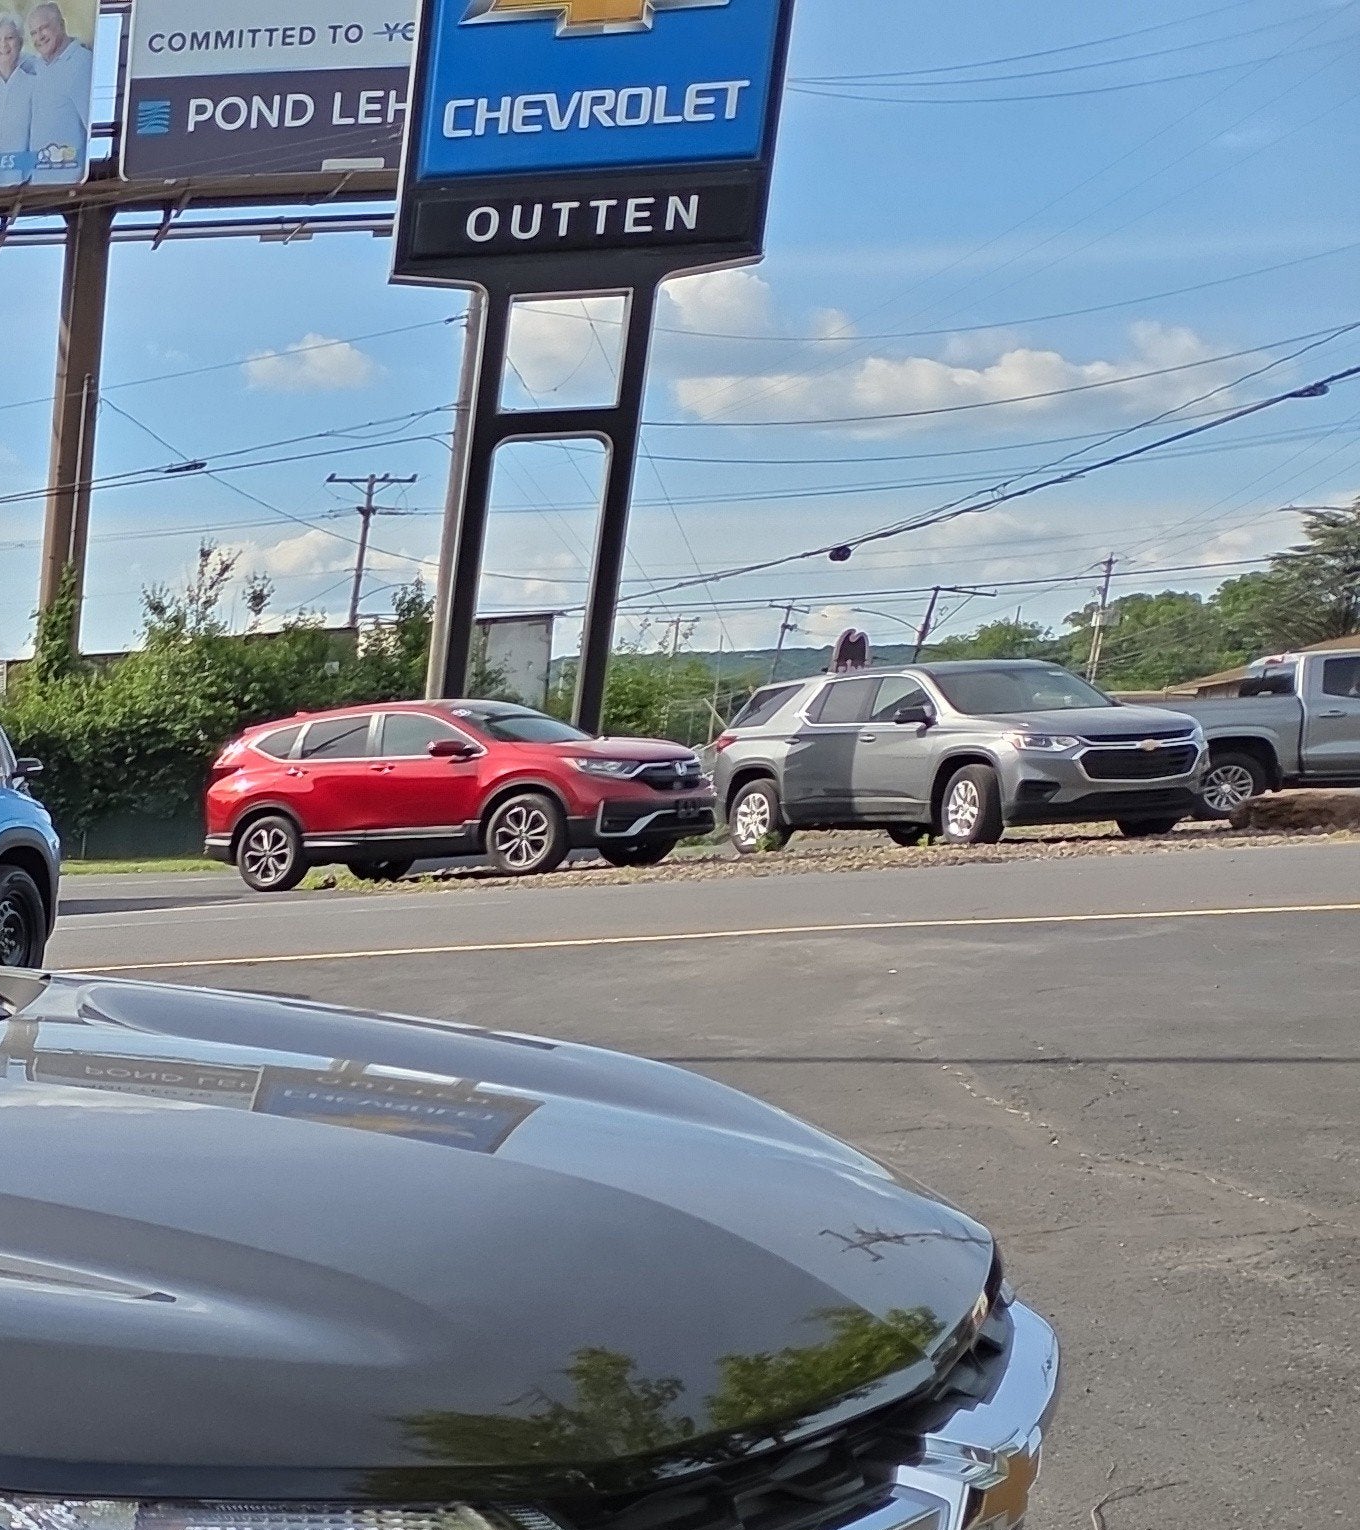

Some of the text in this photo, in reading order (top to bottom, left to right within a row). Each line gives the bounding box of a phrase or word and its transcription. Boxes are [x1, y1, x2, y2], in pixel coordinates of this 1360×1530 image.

[147, 26, 316, 53] COMMITTED
[328, 23, 364, 45] TO
[186, 93, 315, 133] POND
[442, 79, 751, 138] CHEVROLET
[465, 194, 700, 243] OUTTEN
